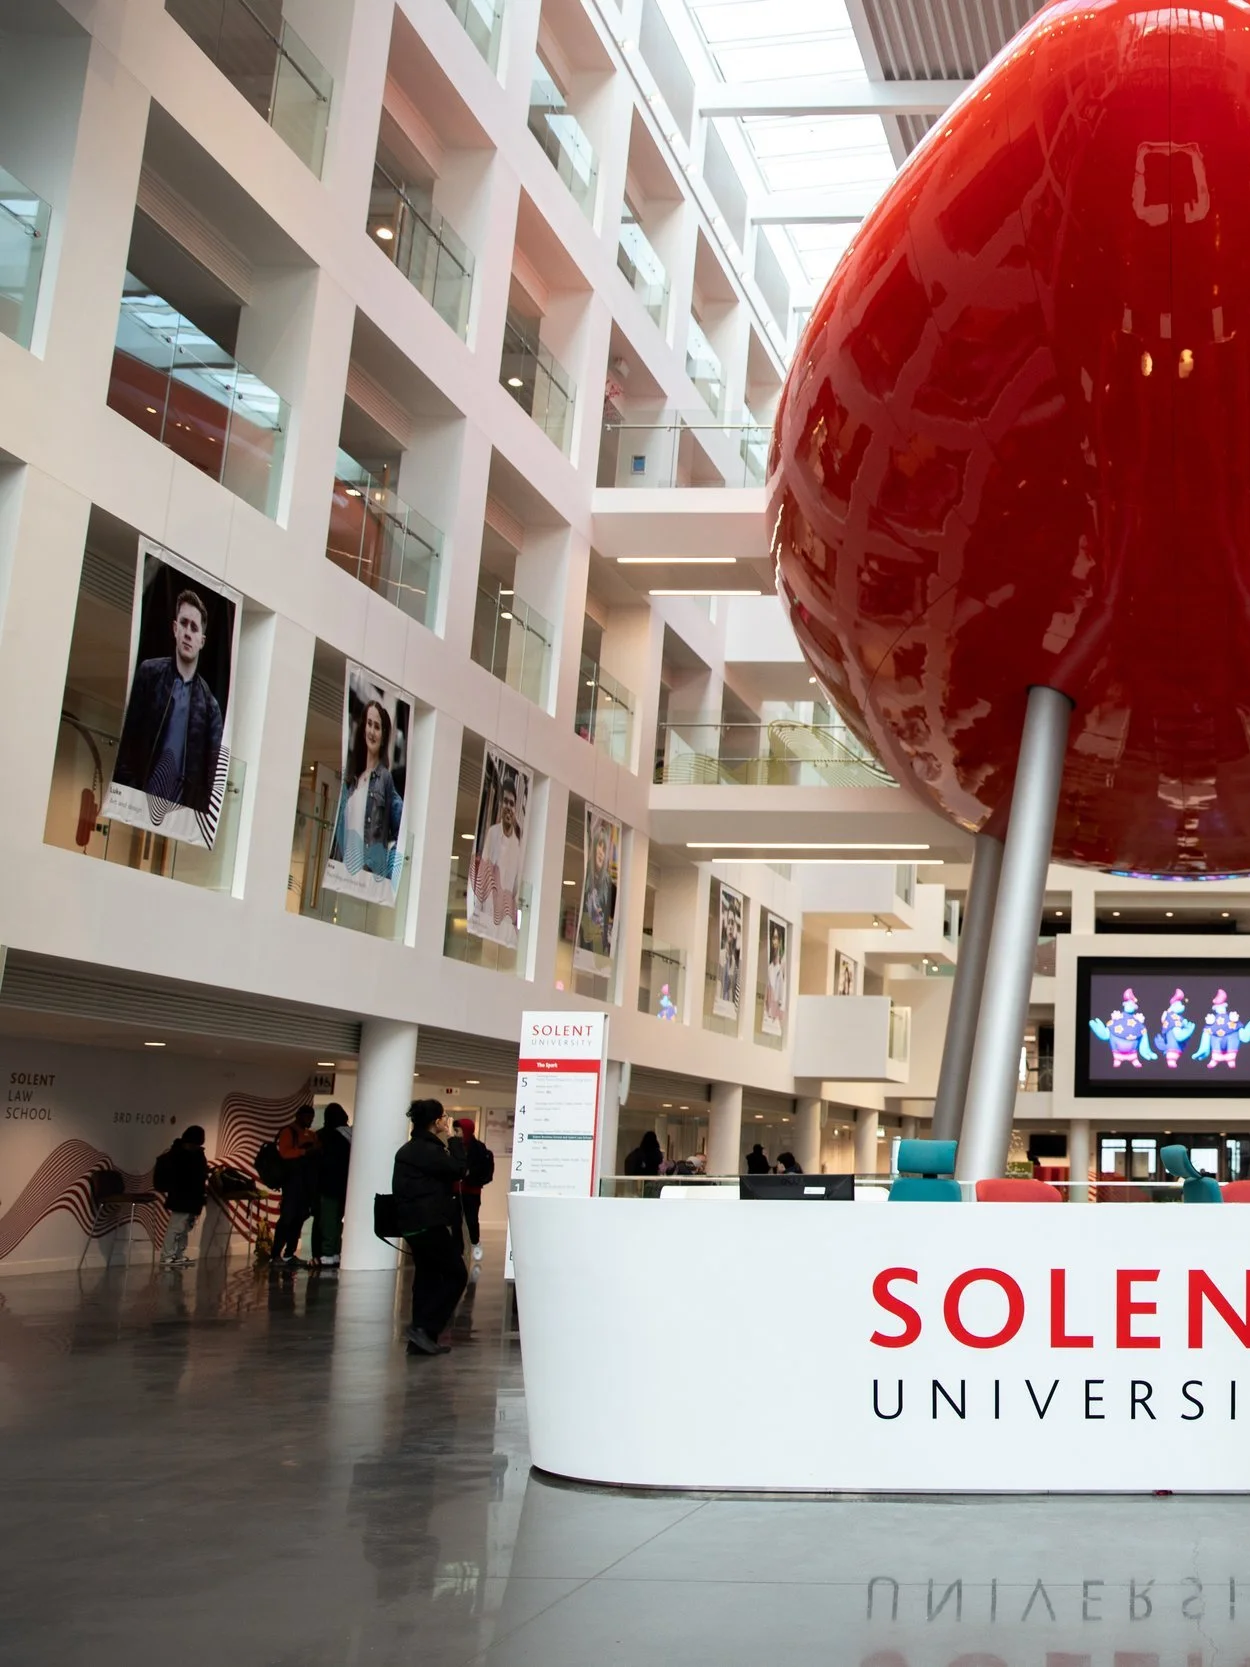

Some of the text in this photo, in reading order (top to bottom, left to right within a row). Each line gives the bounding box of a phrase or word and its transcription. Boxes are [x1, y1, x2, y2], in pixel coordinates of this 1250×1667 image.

[109, 786, 122, 796] Luke
[532, 1024, 593, 1036] SOLENT
[531, 1039, 592, 1047] UNIVERSITY
[10, 1072, 56, 1087] SOLENT
[521, 1076, 528, 1088] 5
[8, 1089, 34, 1102] LAW
[5, 1106, 52, 1121] SCHOOL
[519, 1105, 526, 1115] 4
[113, 1111, 166, 1125] 3RD FLOOR
[517, 1132, 524, 1144] 3
[515, 1160, 523, 1171] 2
